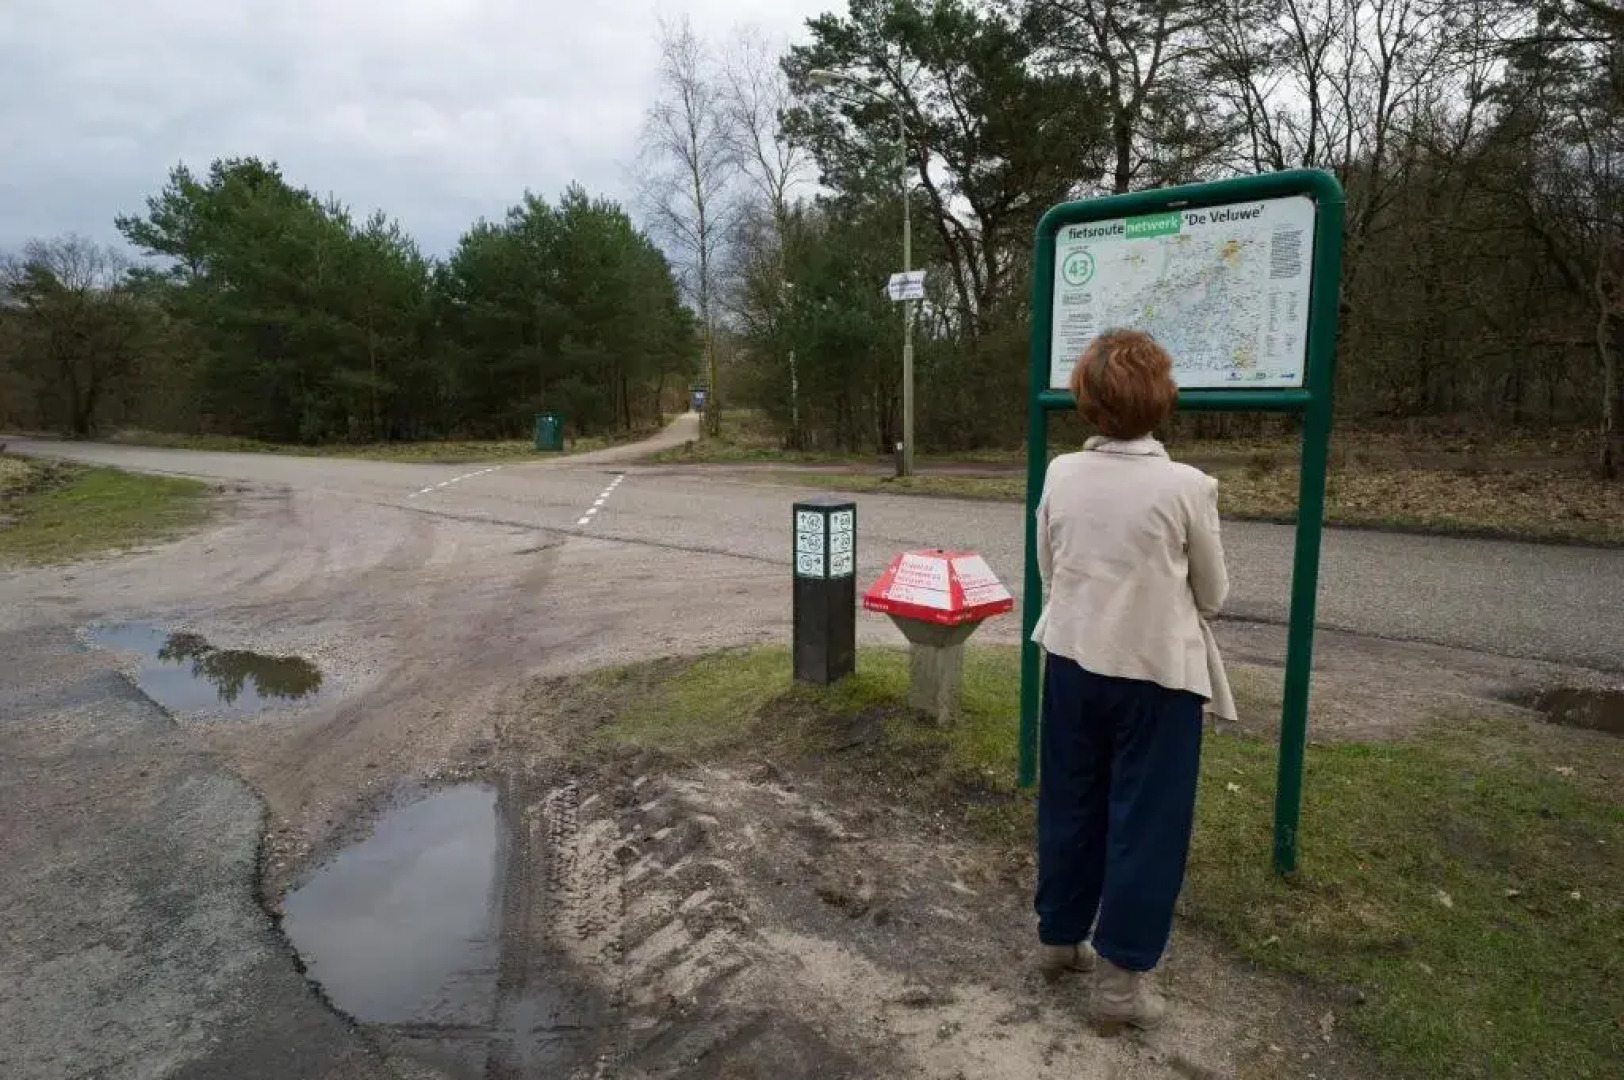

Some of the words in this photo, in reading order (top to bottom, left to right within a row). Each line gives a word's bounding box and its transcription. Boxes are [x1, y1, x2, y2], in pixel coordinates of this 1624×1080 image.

[1068, 224, 1124, 240] fietsroute
[1127, 214, 1179, 234] netwerk
[1067, 259, 1089, 278] 43
